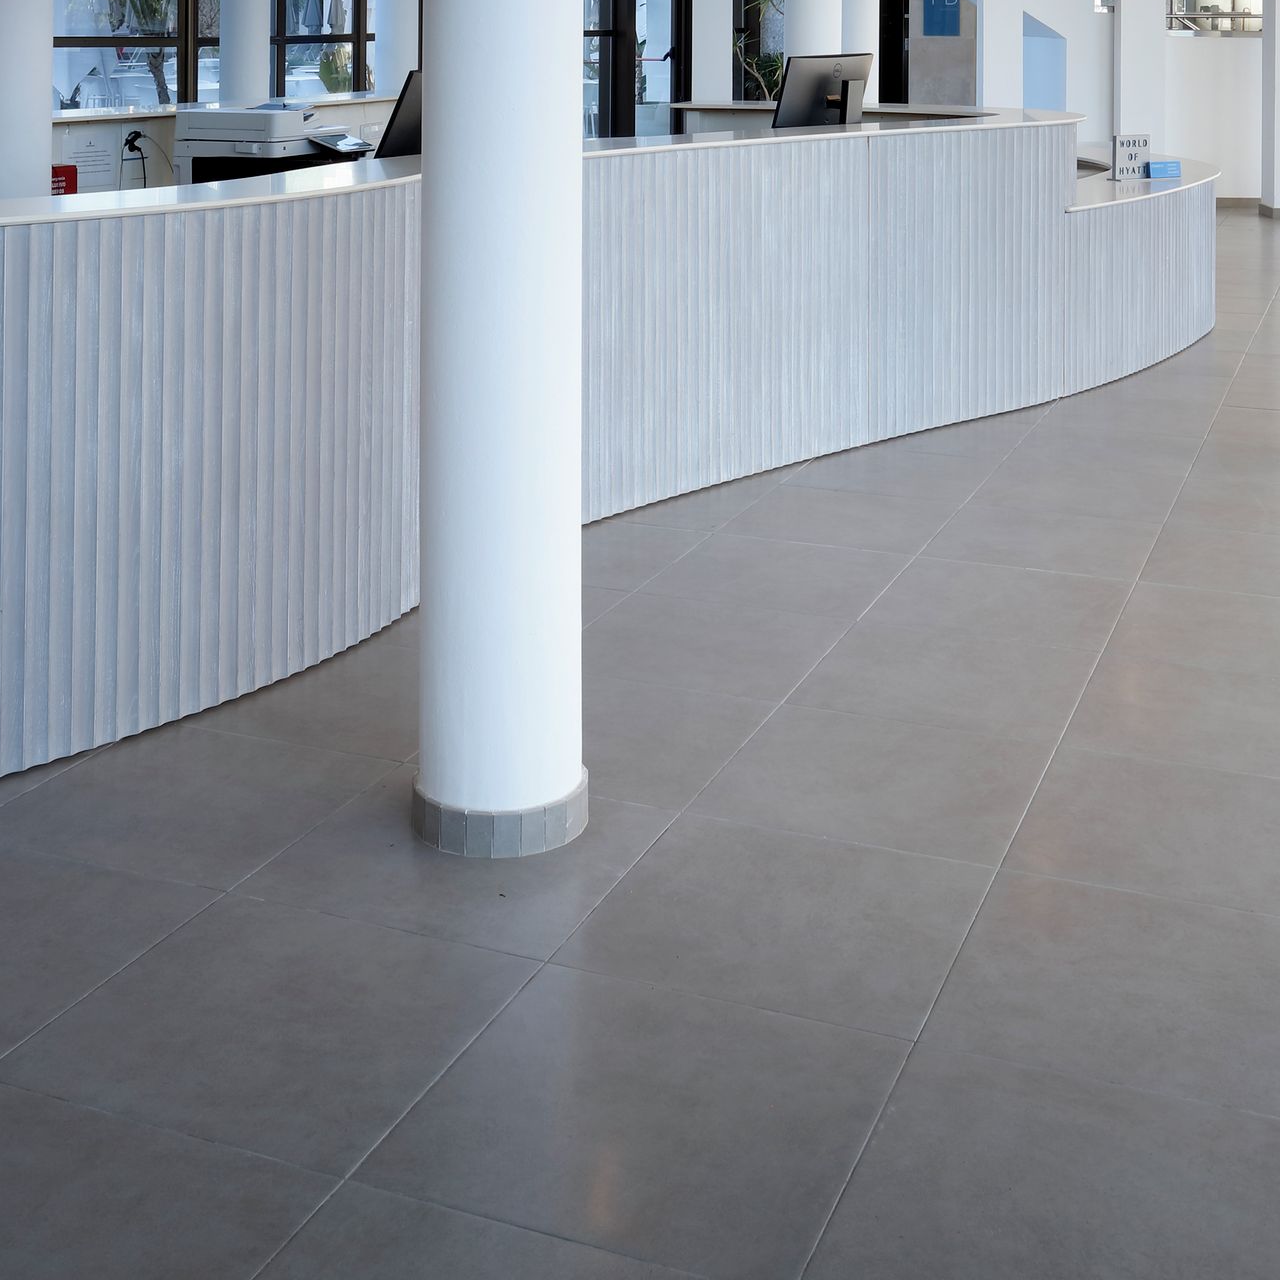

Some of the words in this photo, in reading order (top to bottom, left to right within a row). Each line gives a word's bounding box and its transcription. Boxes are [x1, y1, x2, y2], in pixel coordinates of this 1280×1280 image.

[1119, 139, 1148, 148] WORLD
[1127, 153, 1139, 161] OF
[1119, 165, 1147, 175] HYATT
